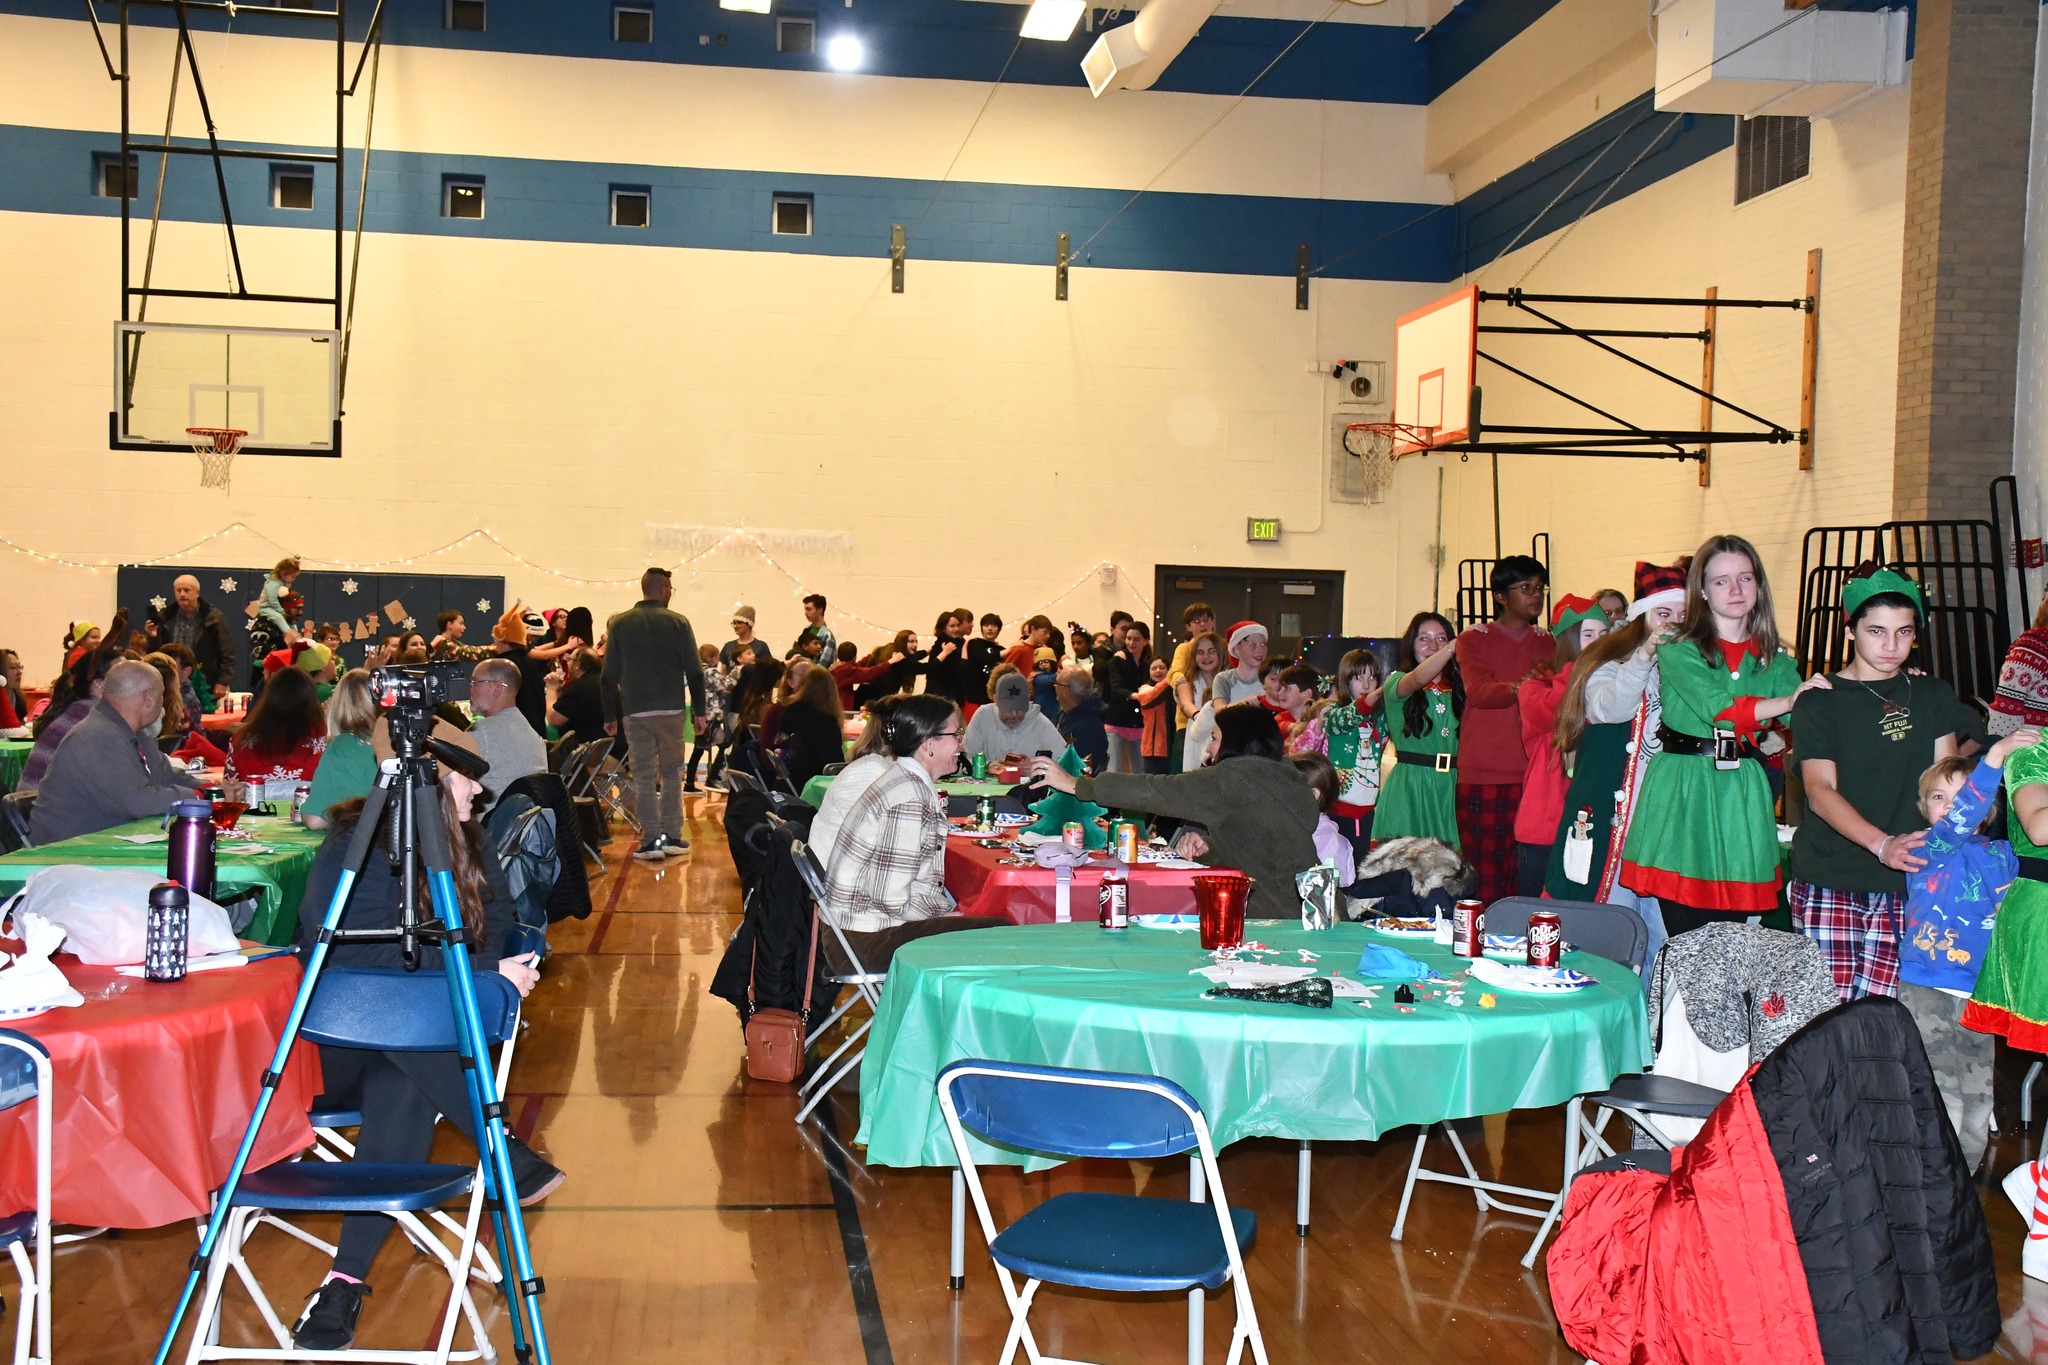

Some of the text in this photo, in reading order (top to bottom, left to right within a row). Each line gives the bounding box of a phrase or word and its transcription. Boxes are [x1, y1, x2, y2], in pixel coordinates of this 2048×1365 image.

[1254, 521, 1276, 538] EXIT
[1883, 719, 1908, 731] MT FUJI
[1530, 926, 1559, 944] Pepper
[1540, 924, 1553, 934] Dr
[1759, 1010, 1799, 1032] Canada
